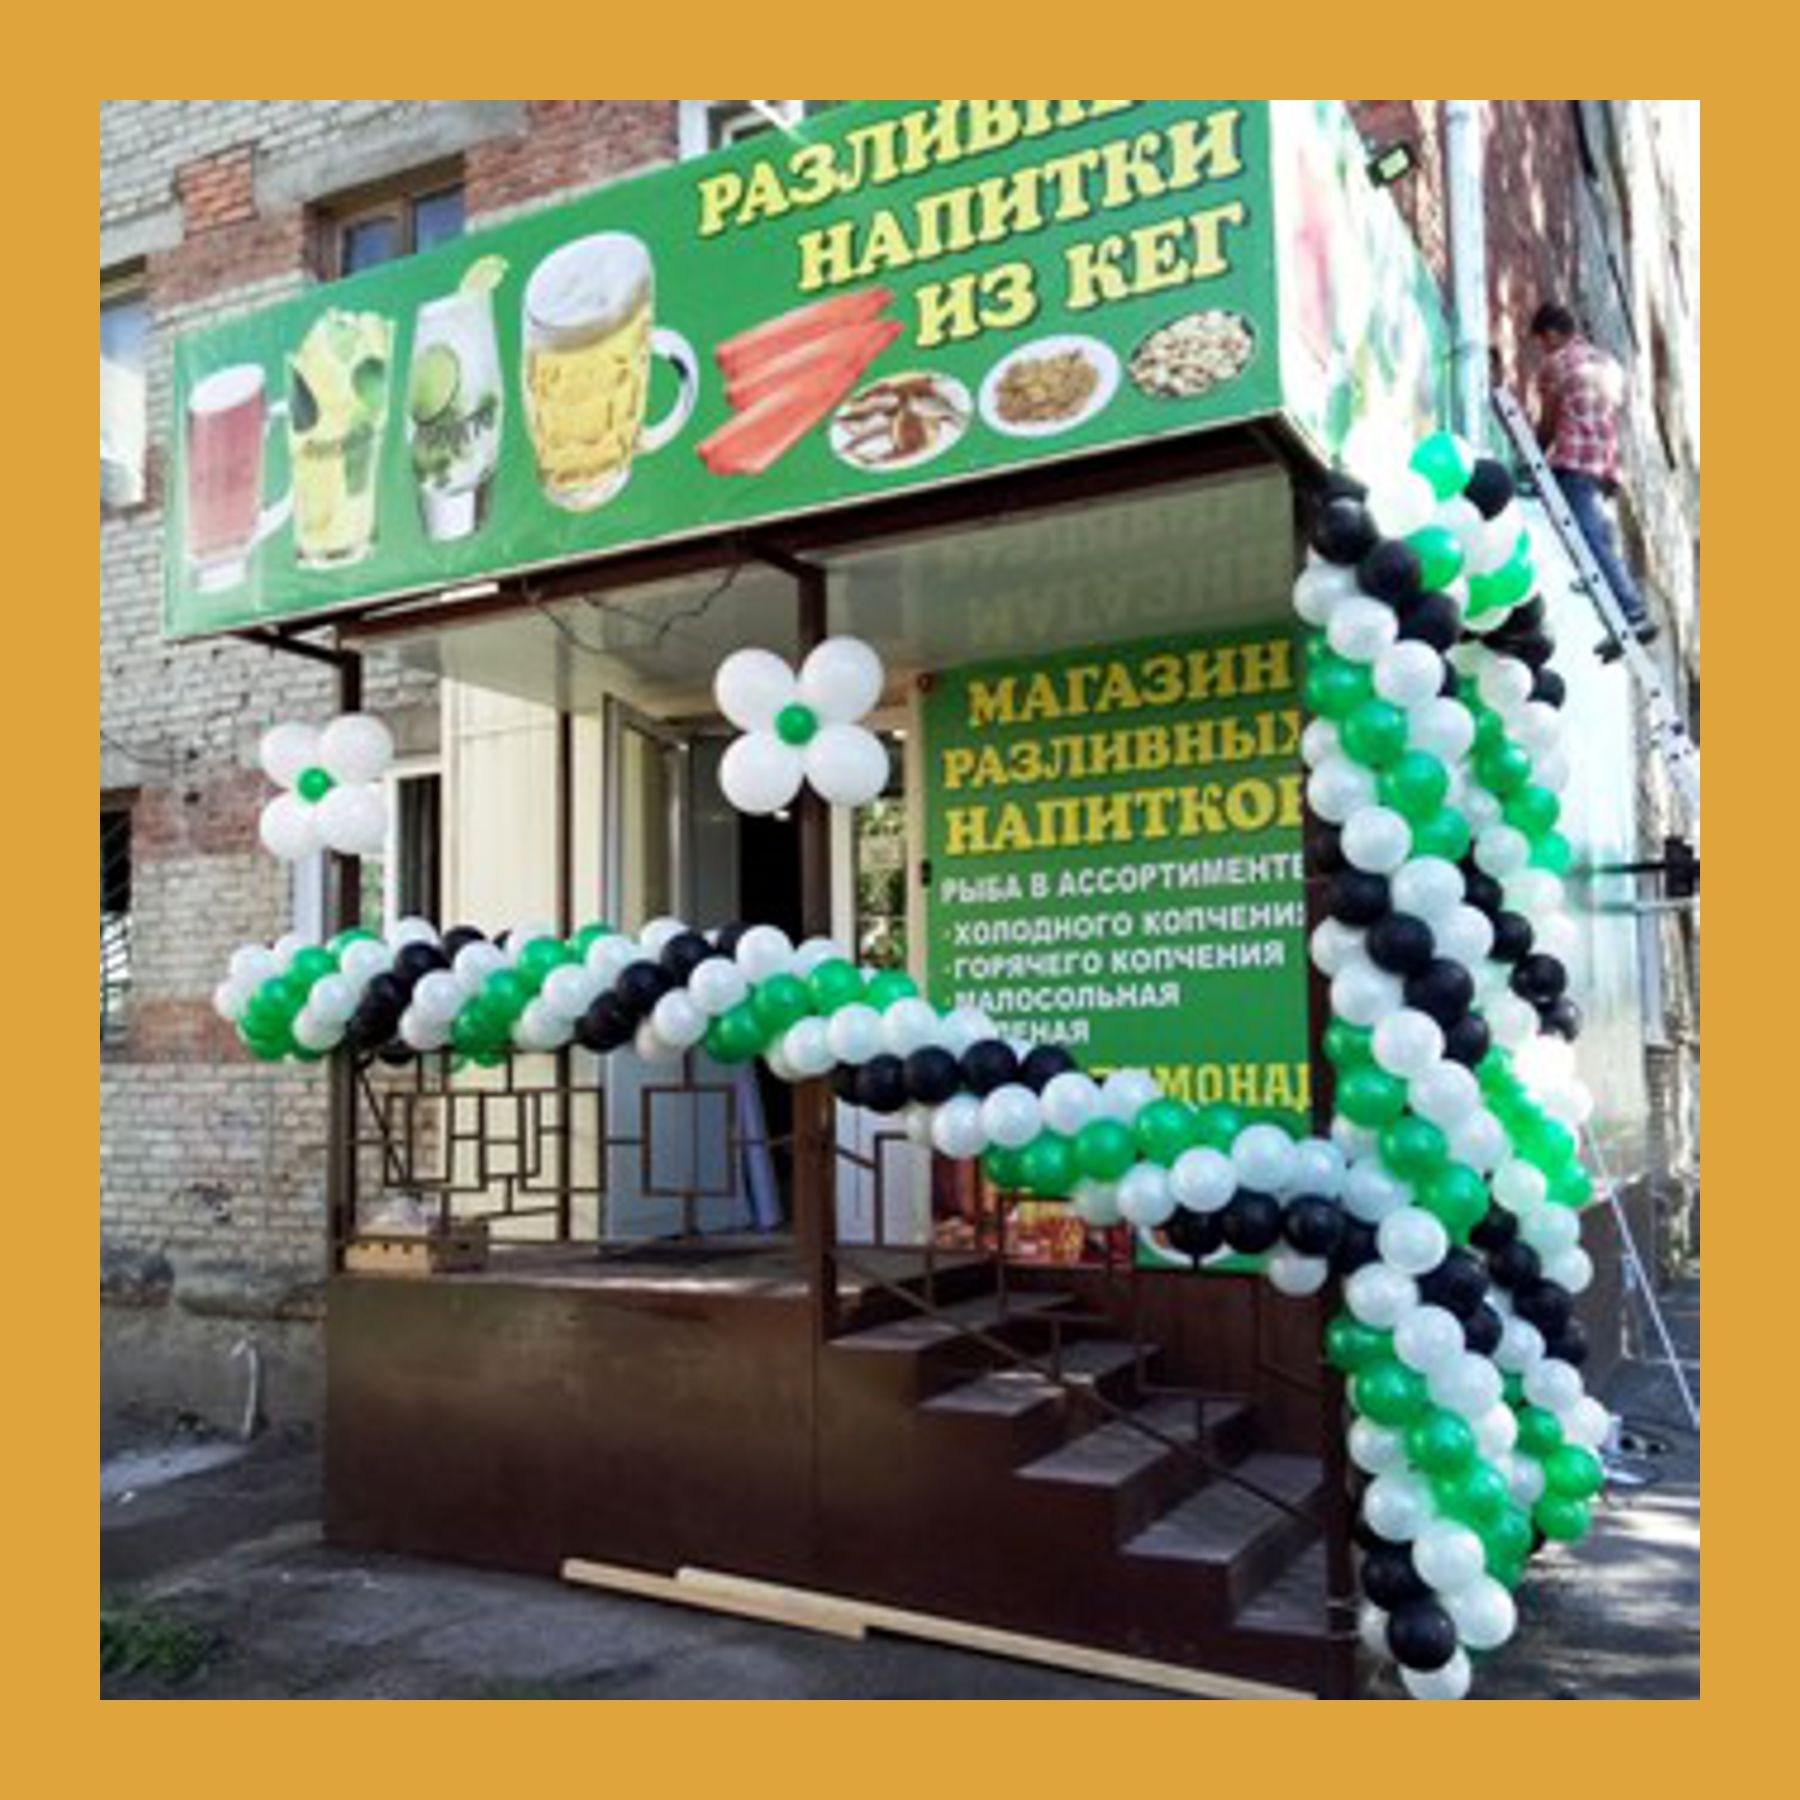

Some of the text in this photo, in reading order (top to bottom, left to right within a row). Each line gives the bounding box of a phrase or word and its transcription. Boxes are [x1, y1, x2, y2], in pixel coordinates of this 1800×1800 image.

[698, 100, 1132, 237] РАЗЛИВ
[798, 109, 1244, 290] НАПИТКИ
[915, 202, 1246, 347] ИЗ КЕГ
[967, 639, 1293, 728] МАГАЗИН
[940, 874, 1022, 903] РЫБА
[1029, 871, 1048, 898] В
[954, 910, 1133, 946] ХОЛОДНОГО
[954, 941, 1285, 981] ГОРЯЧЕГО КОПЧЕНИЯ
[1089, 1063, 1311, 1111] МОНАД
